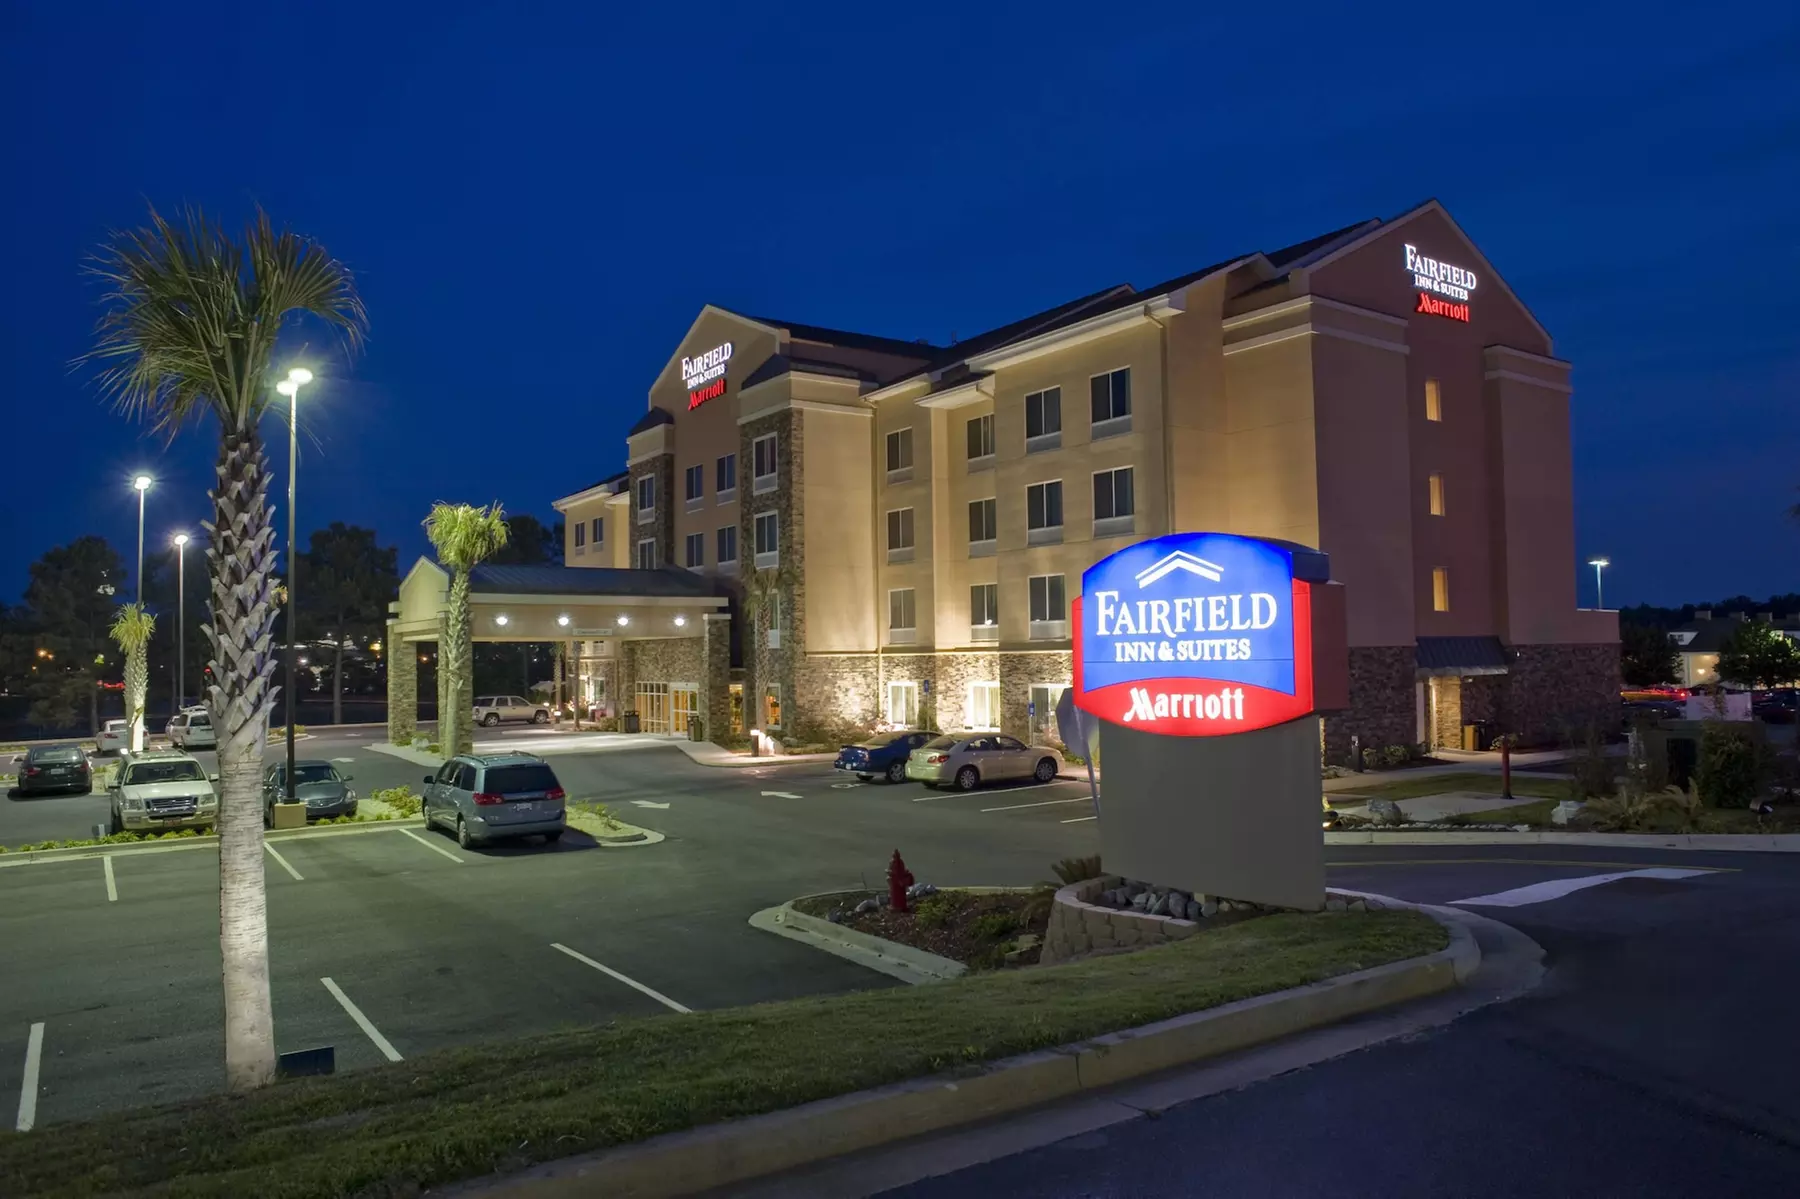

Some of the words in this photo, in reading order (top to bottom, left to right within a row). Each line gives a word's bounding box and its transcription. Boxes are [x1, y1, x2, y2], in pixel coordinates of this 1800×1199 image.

[1404, 243, 1477, 290] FAIRFIELD
[1417, 292, 1469, 322] Marriott
[1441, 282, 1469, 301] SUITES
[682, 342, 732, 380] FAIRFIELD
[687, 378, 725, 412] Marriott
[1094, 590, 1278, 638] FAIRFIELD
[1114, 641, 1156, 662] INN
[1176, 637, 1252, 661] SUITES
[1122, 687, 1245, 722] Marriott
